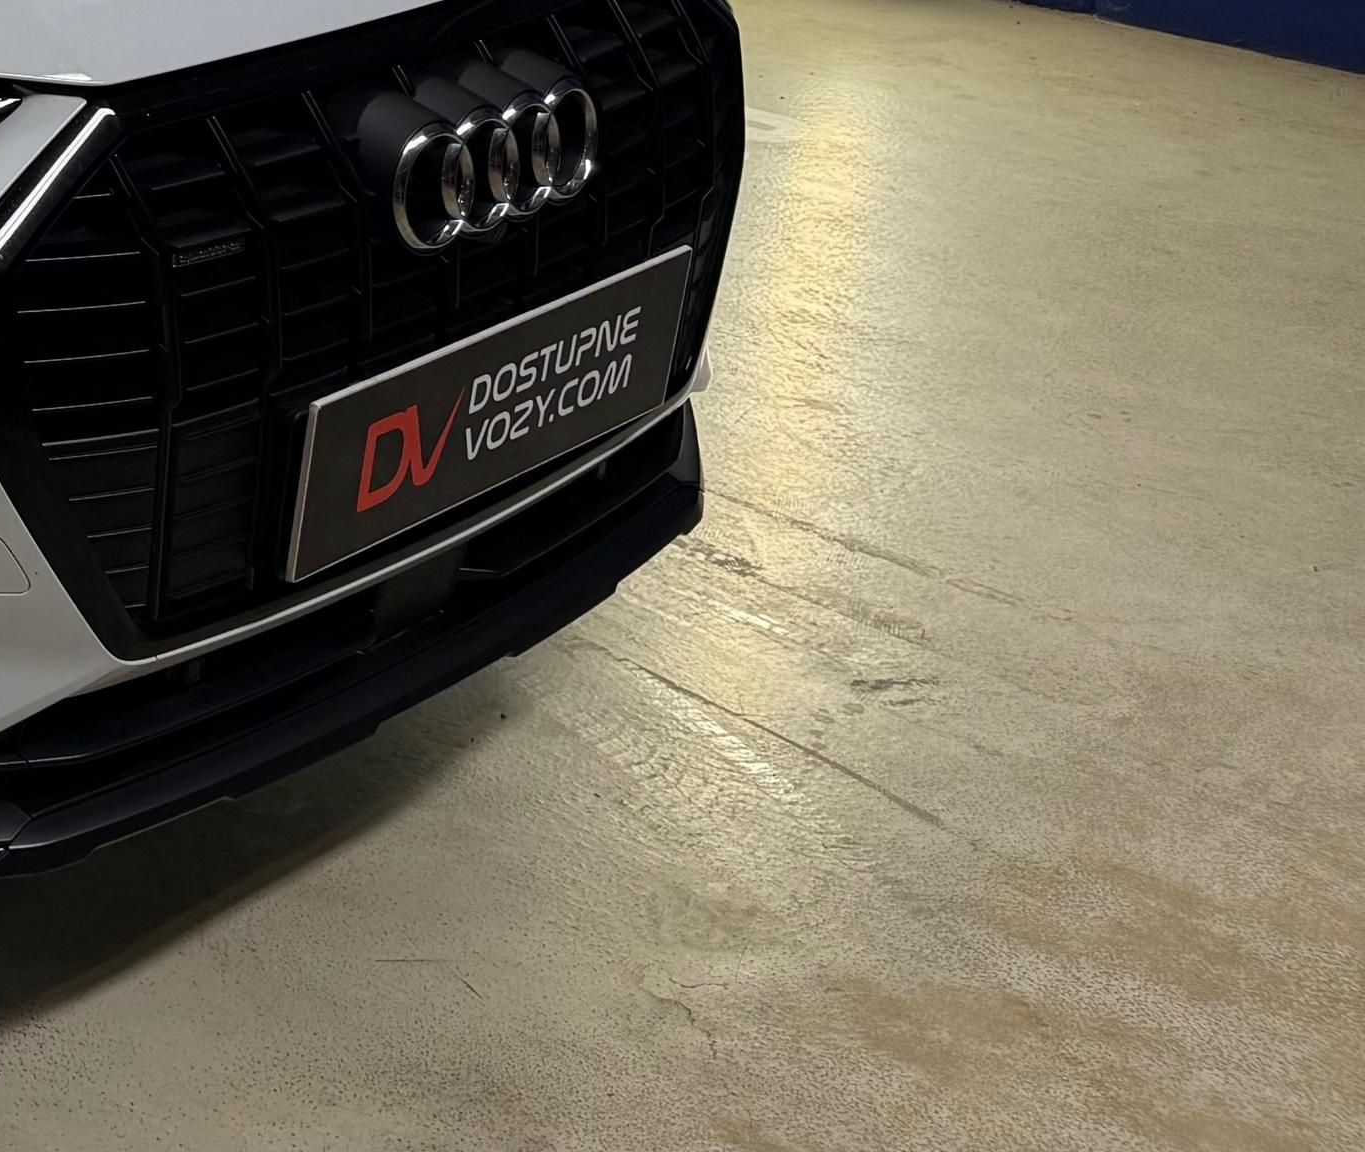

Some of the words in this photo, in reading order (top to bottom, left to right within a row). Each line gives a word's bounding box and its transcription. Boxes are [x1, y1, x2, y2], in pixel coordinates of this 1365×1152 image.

[469, 306, 642, 415] DOSTUPNE
[357, 385, 466, 513] DV
[465, 353, 633, 461] VOZY.COM
